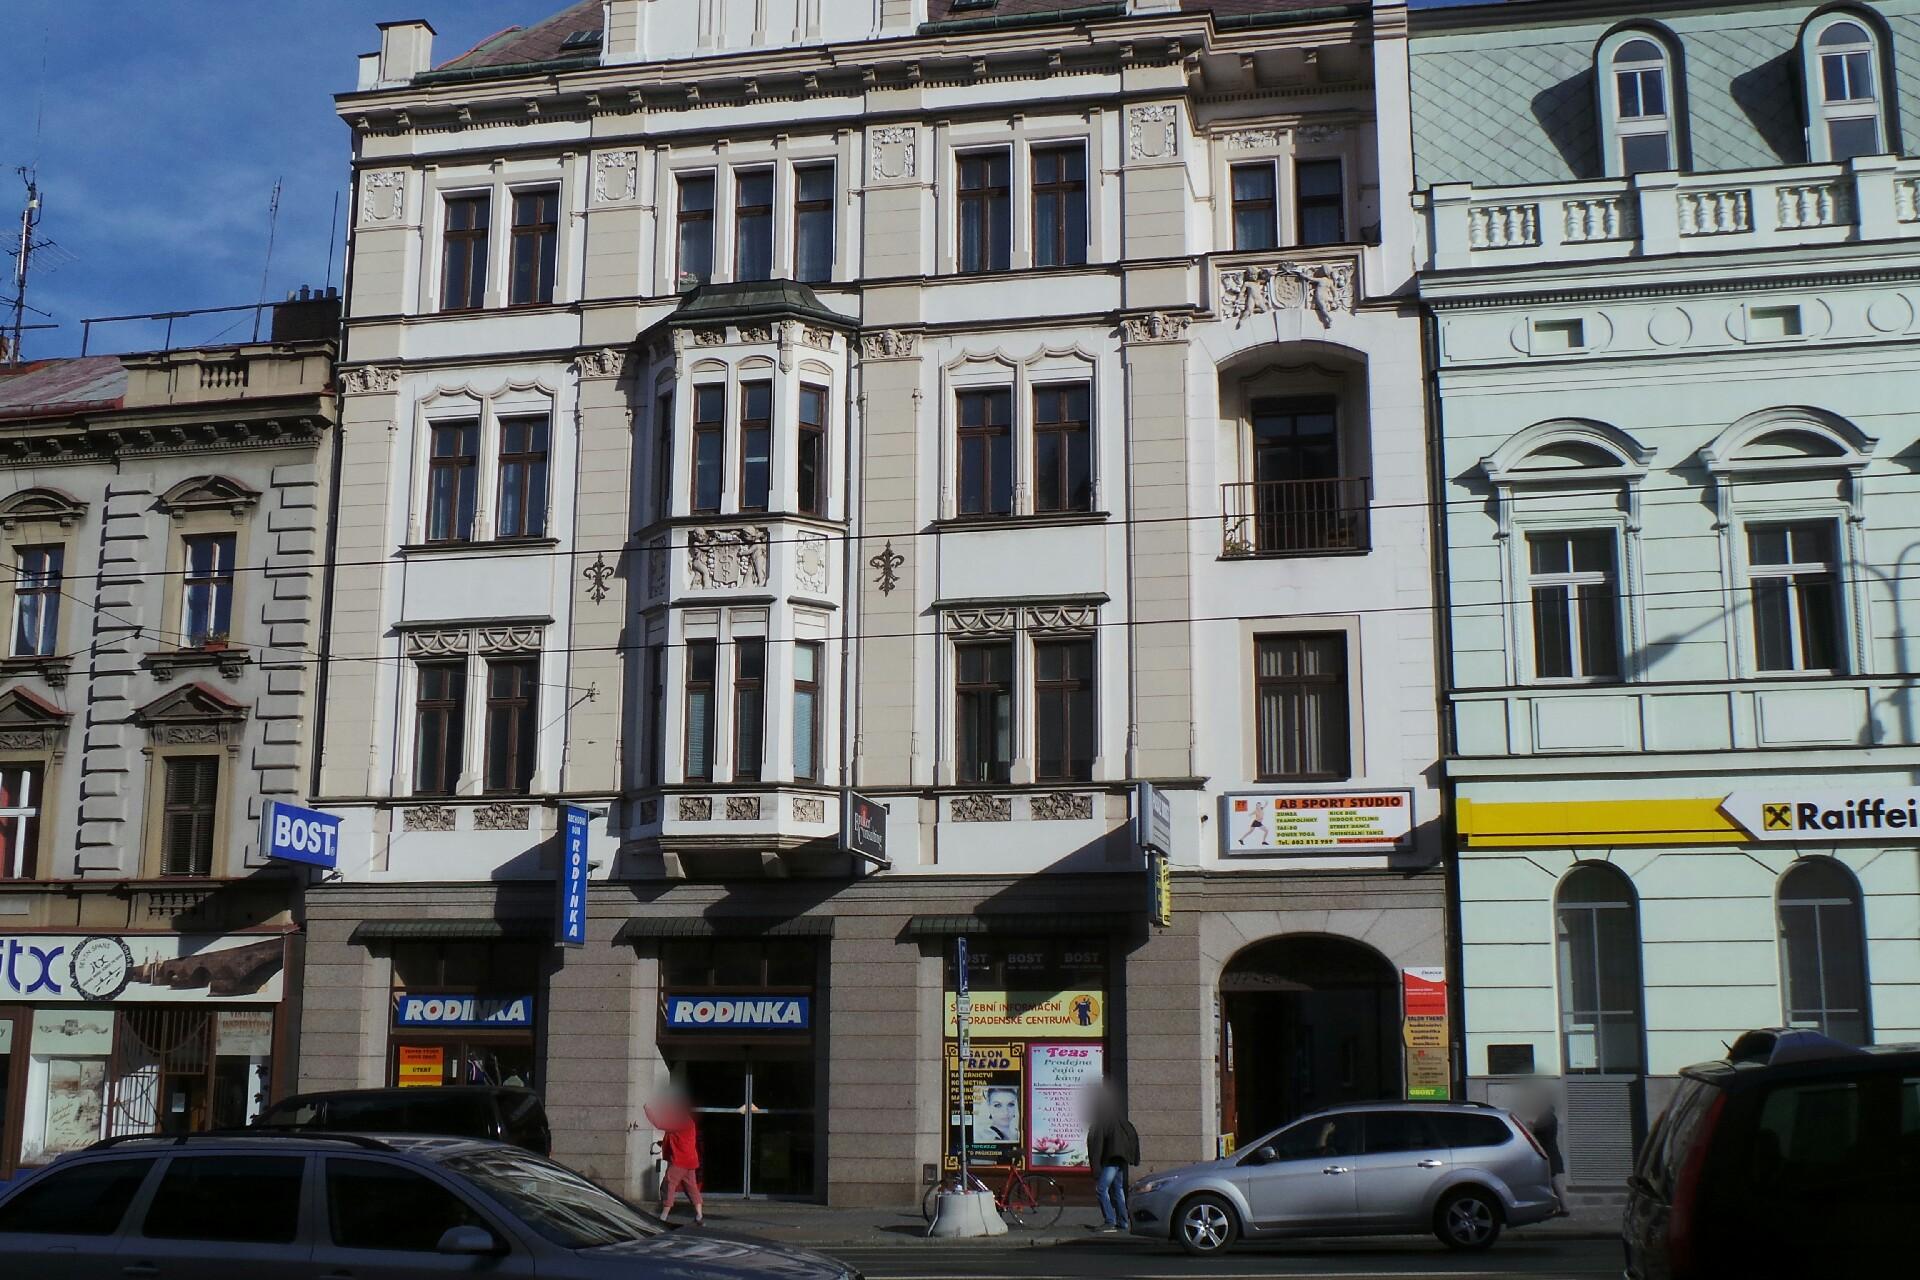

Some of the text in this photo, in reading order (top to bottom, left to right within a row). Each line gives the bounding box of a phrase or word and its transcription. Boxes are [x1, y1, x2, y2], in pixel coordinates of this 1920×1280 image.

[1279, 797, 1401, 808] AB SPORT STUDIO
[1797, 798, 1918, 831] Raiffei
[275, 814, 336, 856] BOST
[569, 839, 581, 937] RODINKA
[404, 1000, 525, 1020] RODINKA
[674, 1001, 801, 1023] RODINKA
[964, 1013, 1022, 1025] ORADENSKÉ
[1026, 1016, 1071, 1025] CENTRUM
[969, 1050, 1003, 1058] SALON
[1046, 1048, 1088, 1057] Teas
